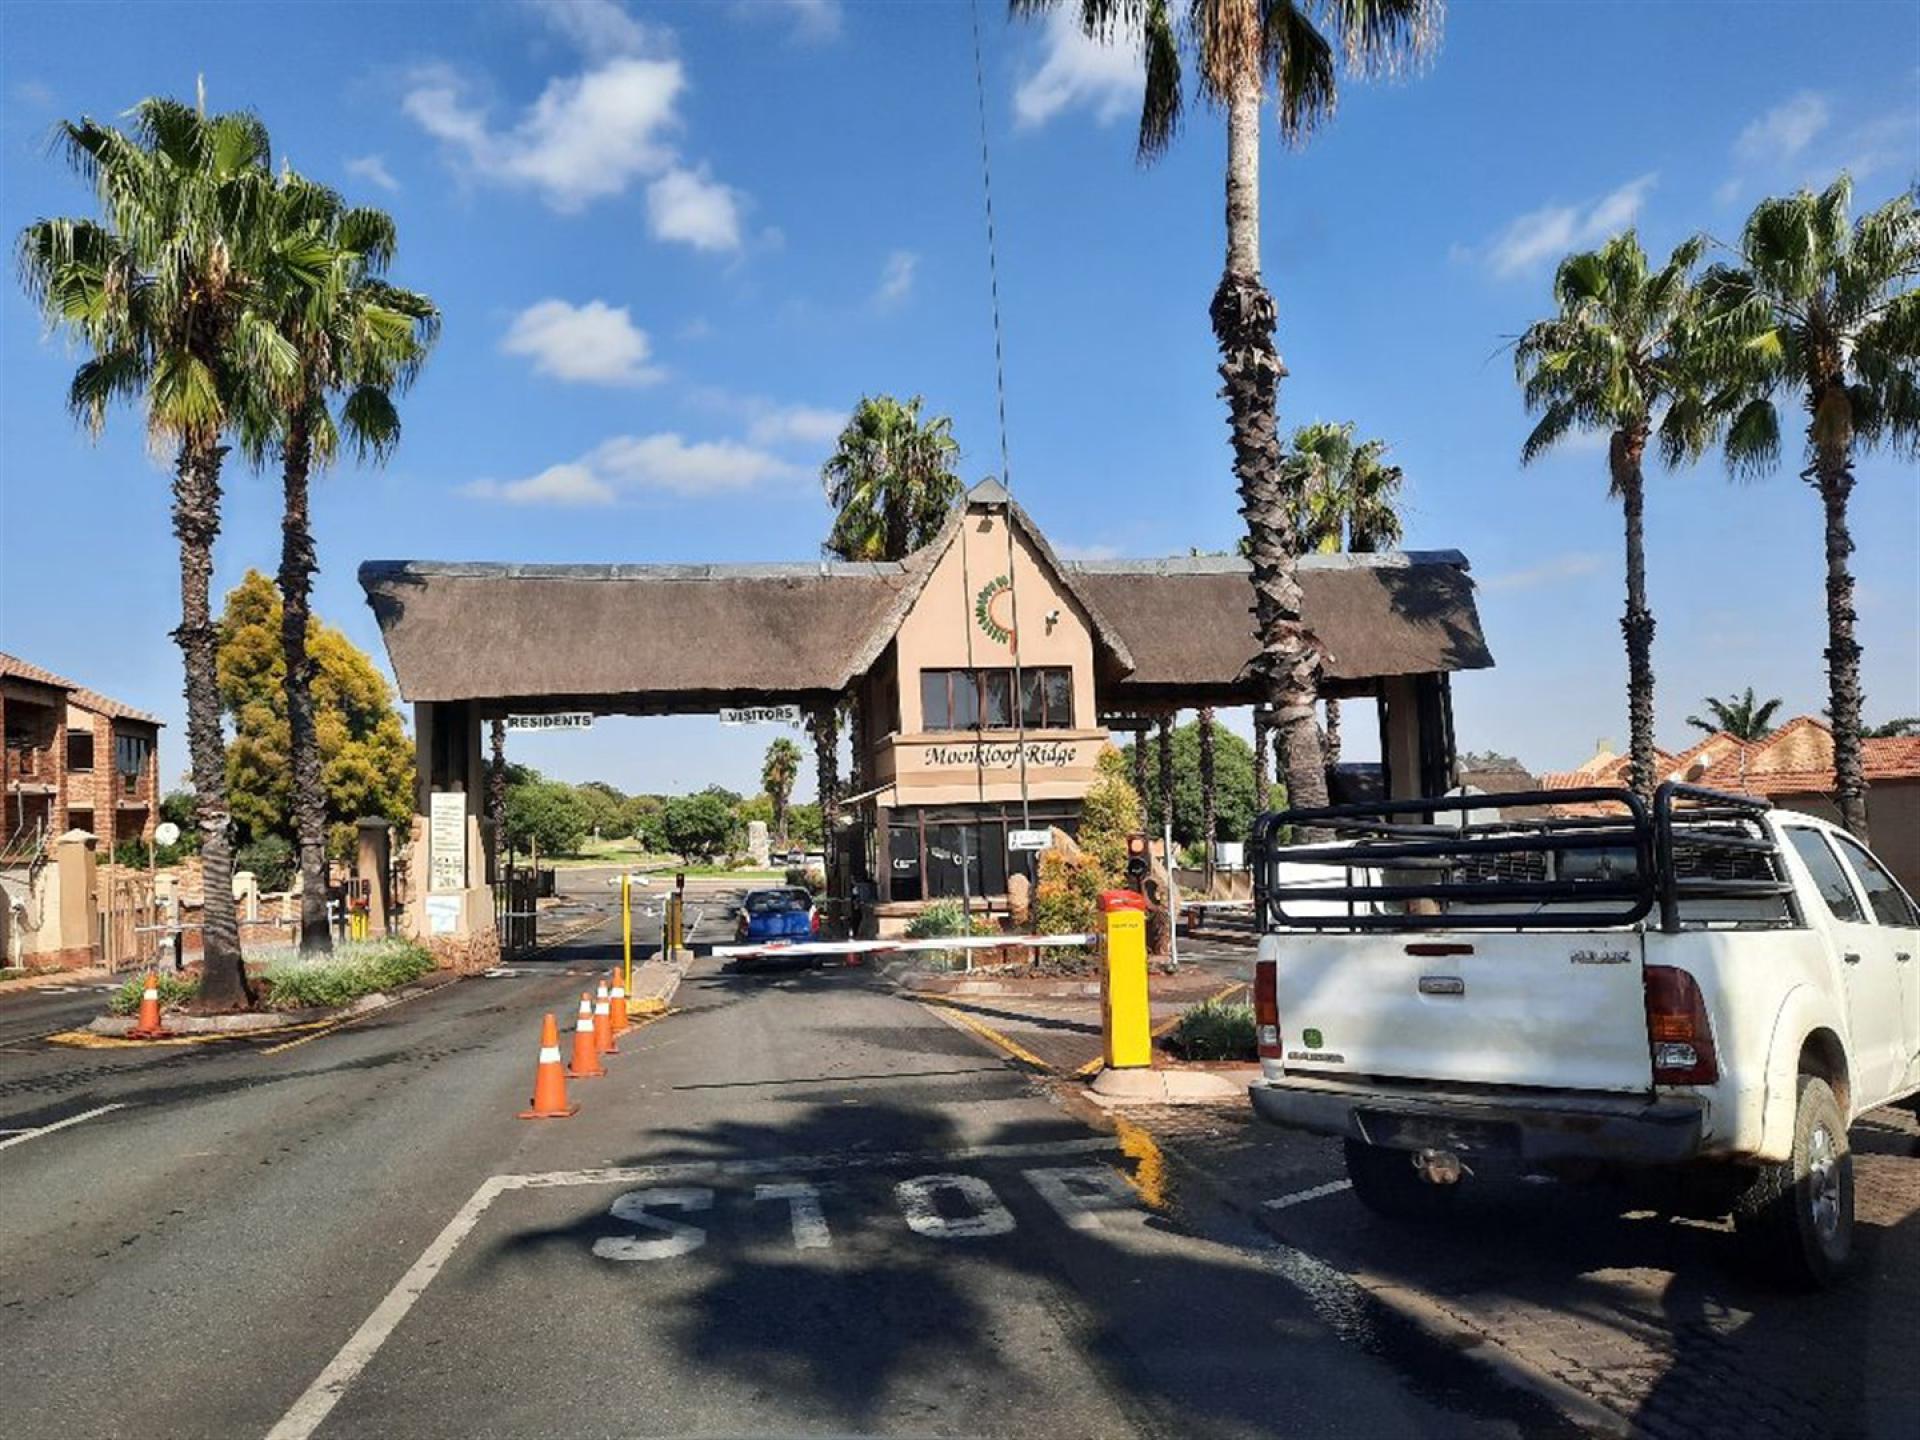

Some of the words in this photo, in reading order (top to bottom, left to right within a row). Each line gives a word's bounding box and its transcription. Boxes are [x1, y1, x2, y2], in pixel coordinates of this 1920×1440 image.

[508, 715, 592, 728] RESIDENTS
[728, 707, 793, 721] VISITORS
[1025, 741, 1077, 767] Ridge
[592, 1167, 1140, 1260] STOP
